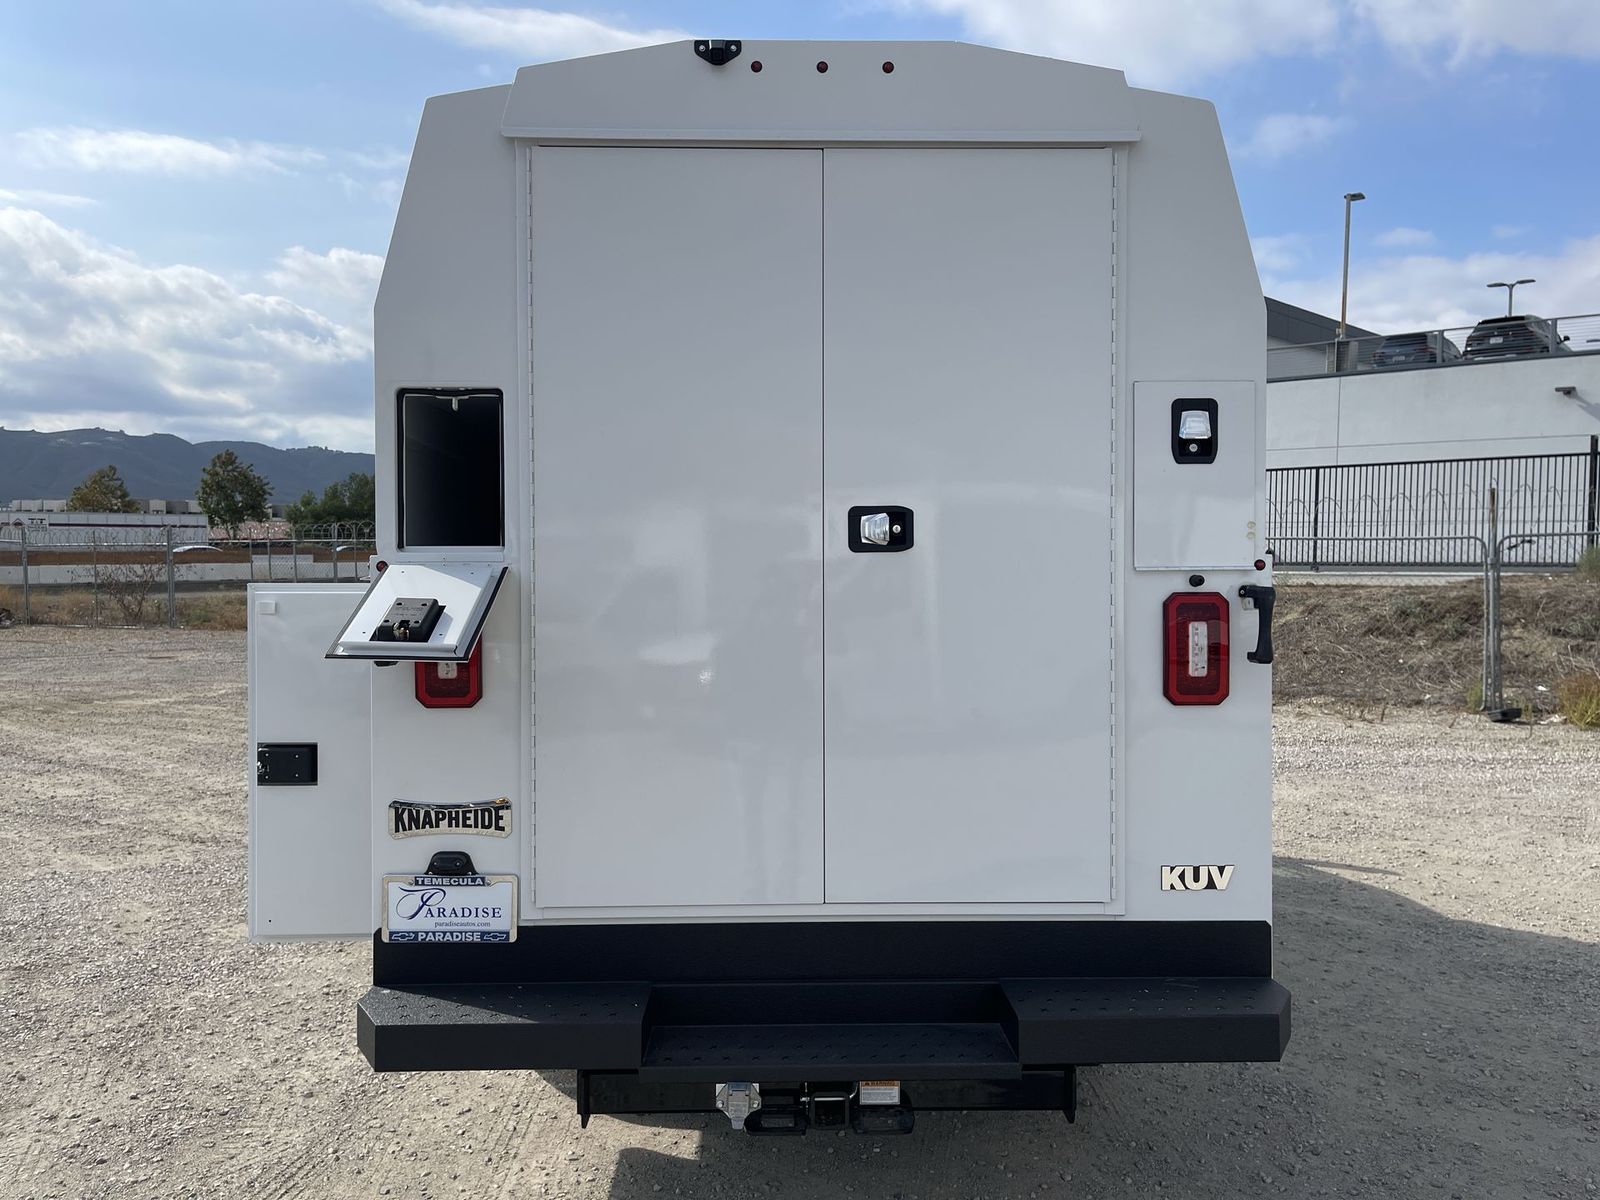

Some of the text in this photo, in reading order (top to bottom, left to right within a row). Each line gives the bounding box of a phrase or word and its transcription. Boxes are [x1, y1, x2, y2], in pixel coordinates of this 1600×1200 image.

[394, 805, 505, 833] KNAPHEIDE
[416, 877, 483, 886] TEMECULA
[1161, 865, 1235, 891] KUV
[396, 886, 502, 920] PARADISE
[434, 921, 491, 929] paradiseautos.com
[418, 932, 481, 942] PARADISE
